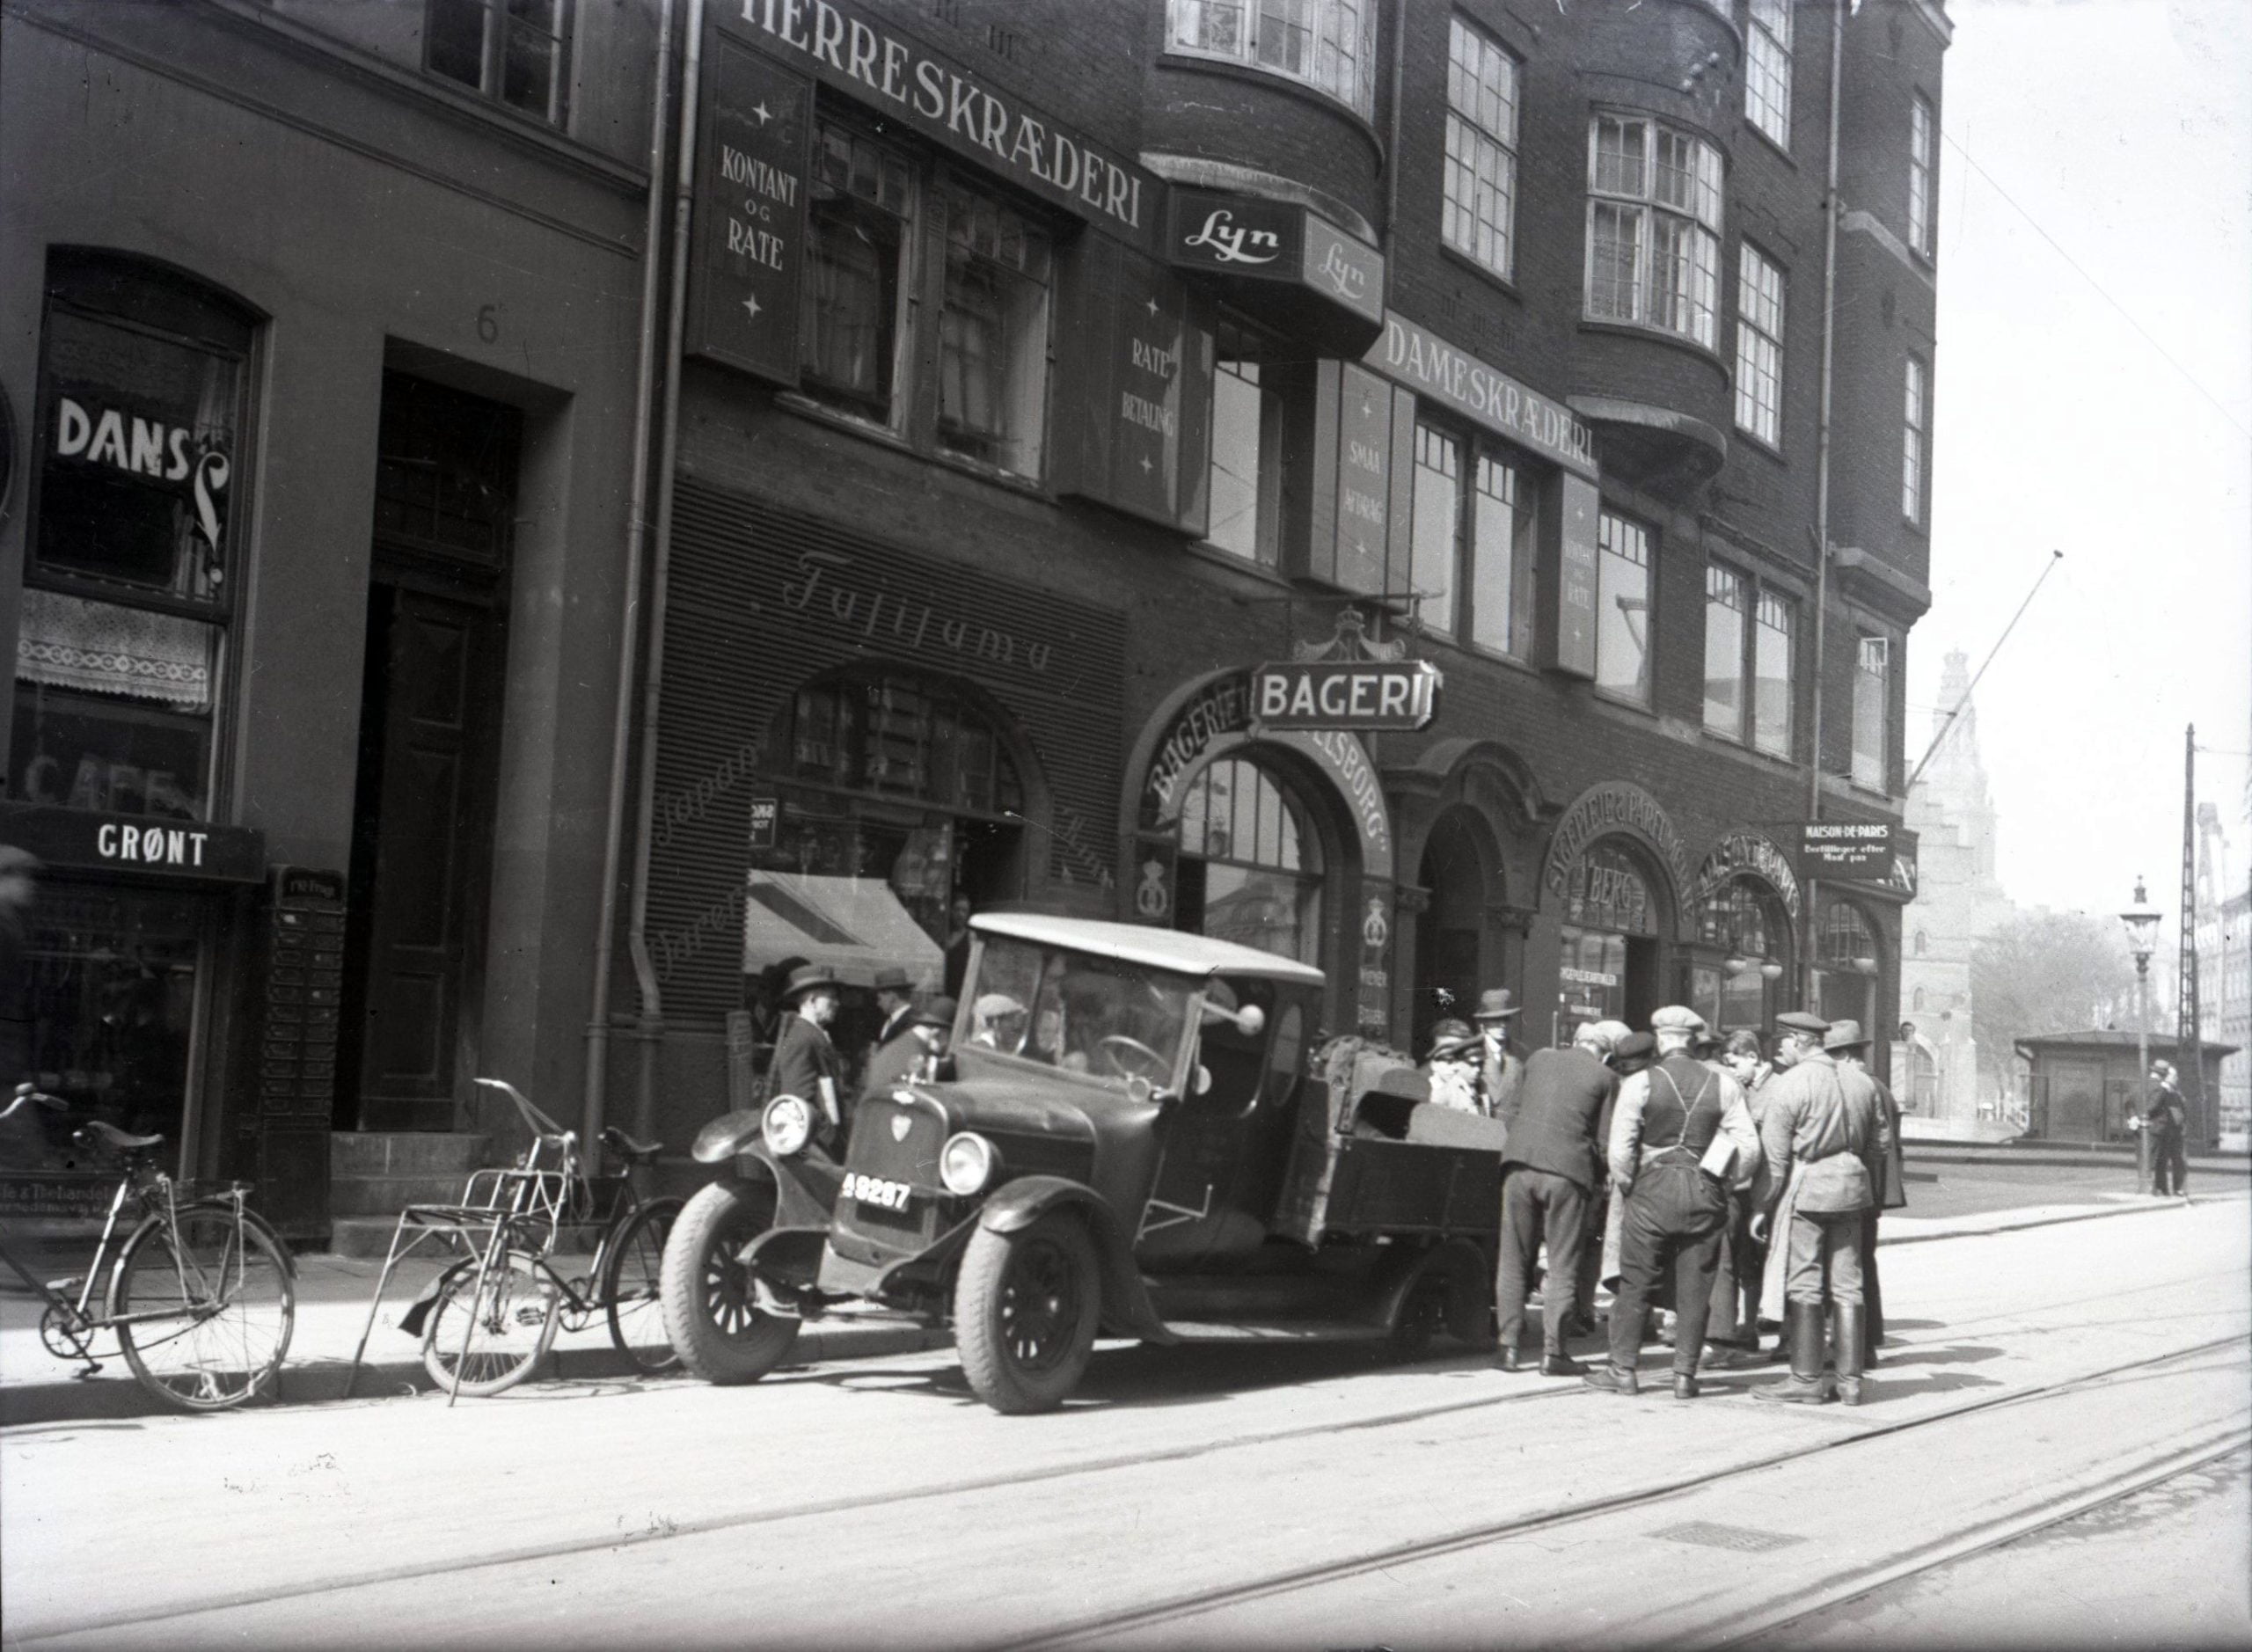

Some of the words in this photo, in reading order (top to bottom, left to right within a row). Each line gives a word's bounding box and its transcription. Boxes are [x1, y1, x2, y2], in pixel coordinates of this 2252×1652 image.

[720, 144, 798, 208] KONTANT
[745, 199, 771, 223] OG
[1184, 209, 1281, 264] Lyn
[727, 218, 784, 272] RATE
[1318, 242, 1364, 300] Lyn
[478, 303, 499, 344] 6
[1131, 337, 1172, 379] RATE
[1122, 391, 1174, 438] BETALING
[1386, 318, 1595, 469] DAMESKRÆDERI
[57, 397, 193, 481] DANS
[1261, 674, 1423, 716] BAGERI
[1147, 685, 1249, 804] BAGERIET
[656, 744, 757, 847] Japan
[99, 823, 208, 866] GRØNT
